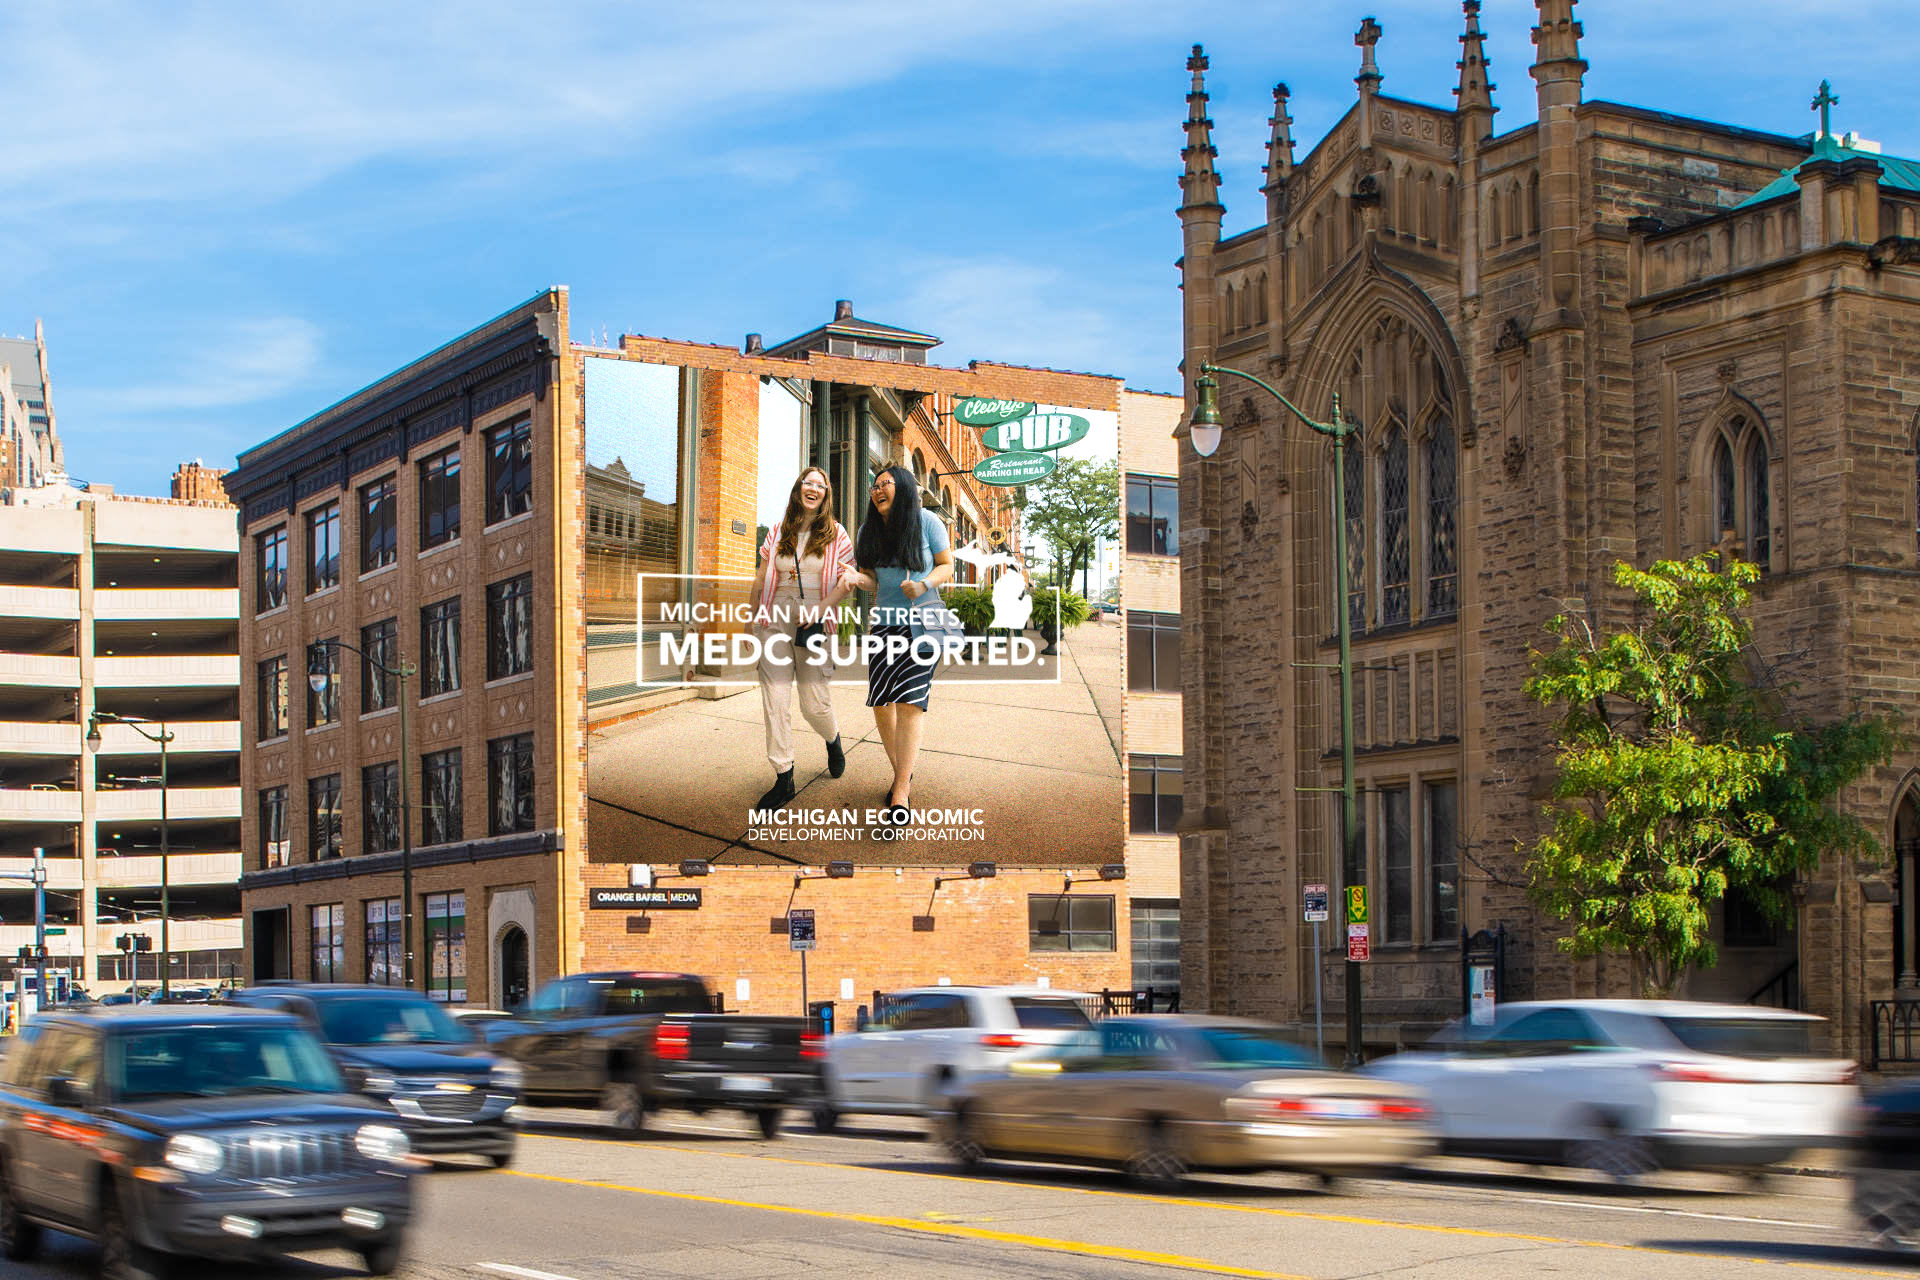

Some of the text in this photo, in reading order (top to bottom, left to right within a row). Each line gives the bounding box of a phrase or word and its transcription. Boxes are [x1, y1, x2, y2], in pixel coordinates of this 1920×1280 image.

[998, 415, 1072, 449] PUB
[990, 457, 1044, 470] Restaurant
[977, 466, 1046, 478] PARKING IN REAR
[660, 602, 966, 630] MICHIGAN MAIN STREETS,
[660, 632, 1046, 667] MEDC SUPPORTED.
[748, 808, 984, 826] MICHIGAN ECONOMIC
[748, 828, 985, 841] DEVELOPMENT CORPORATION
[597, 892, 635, 902] ORANGE
[670, 892, 698, 902] MEDIA
